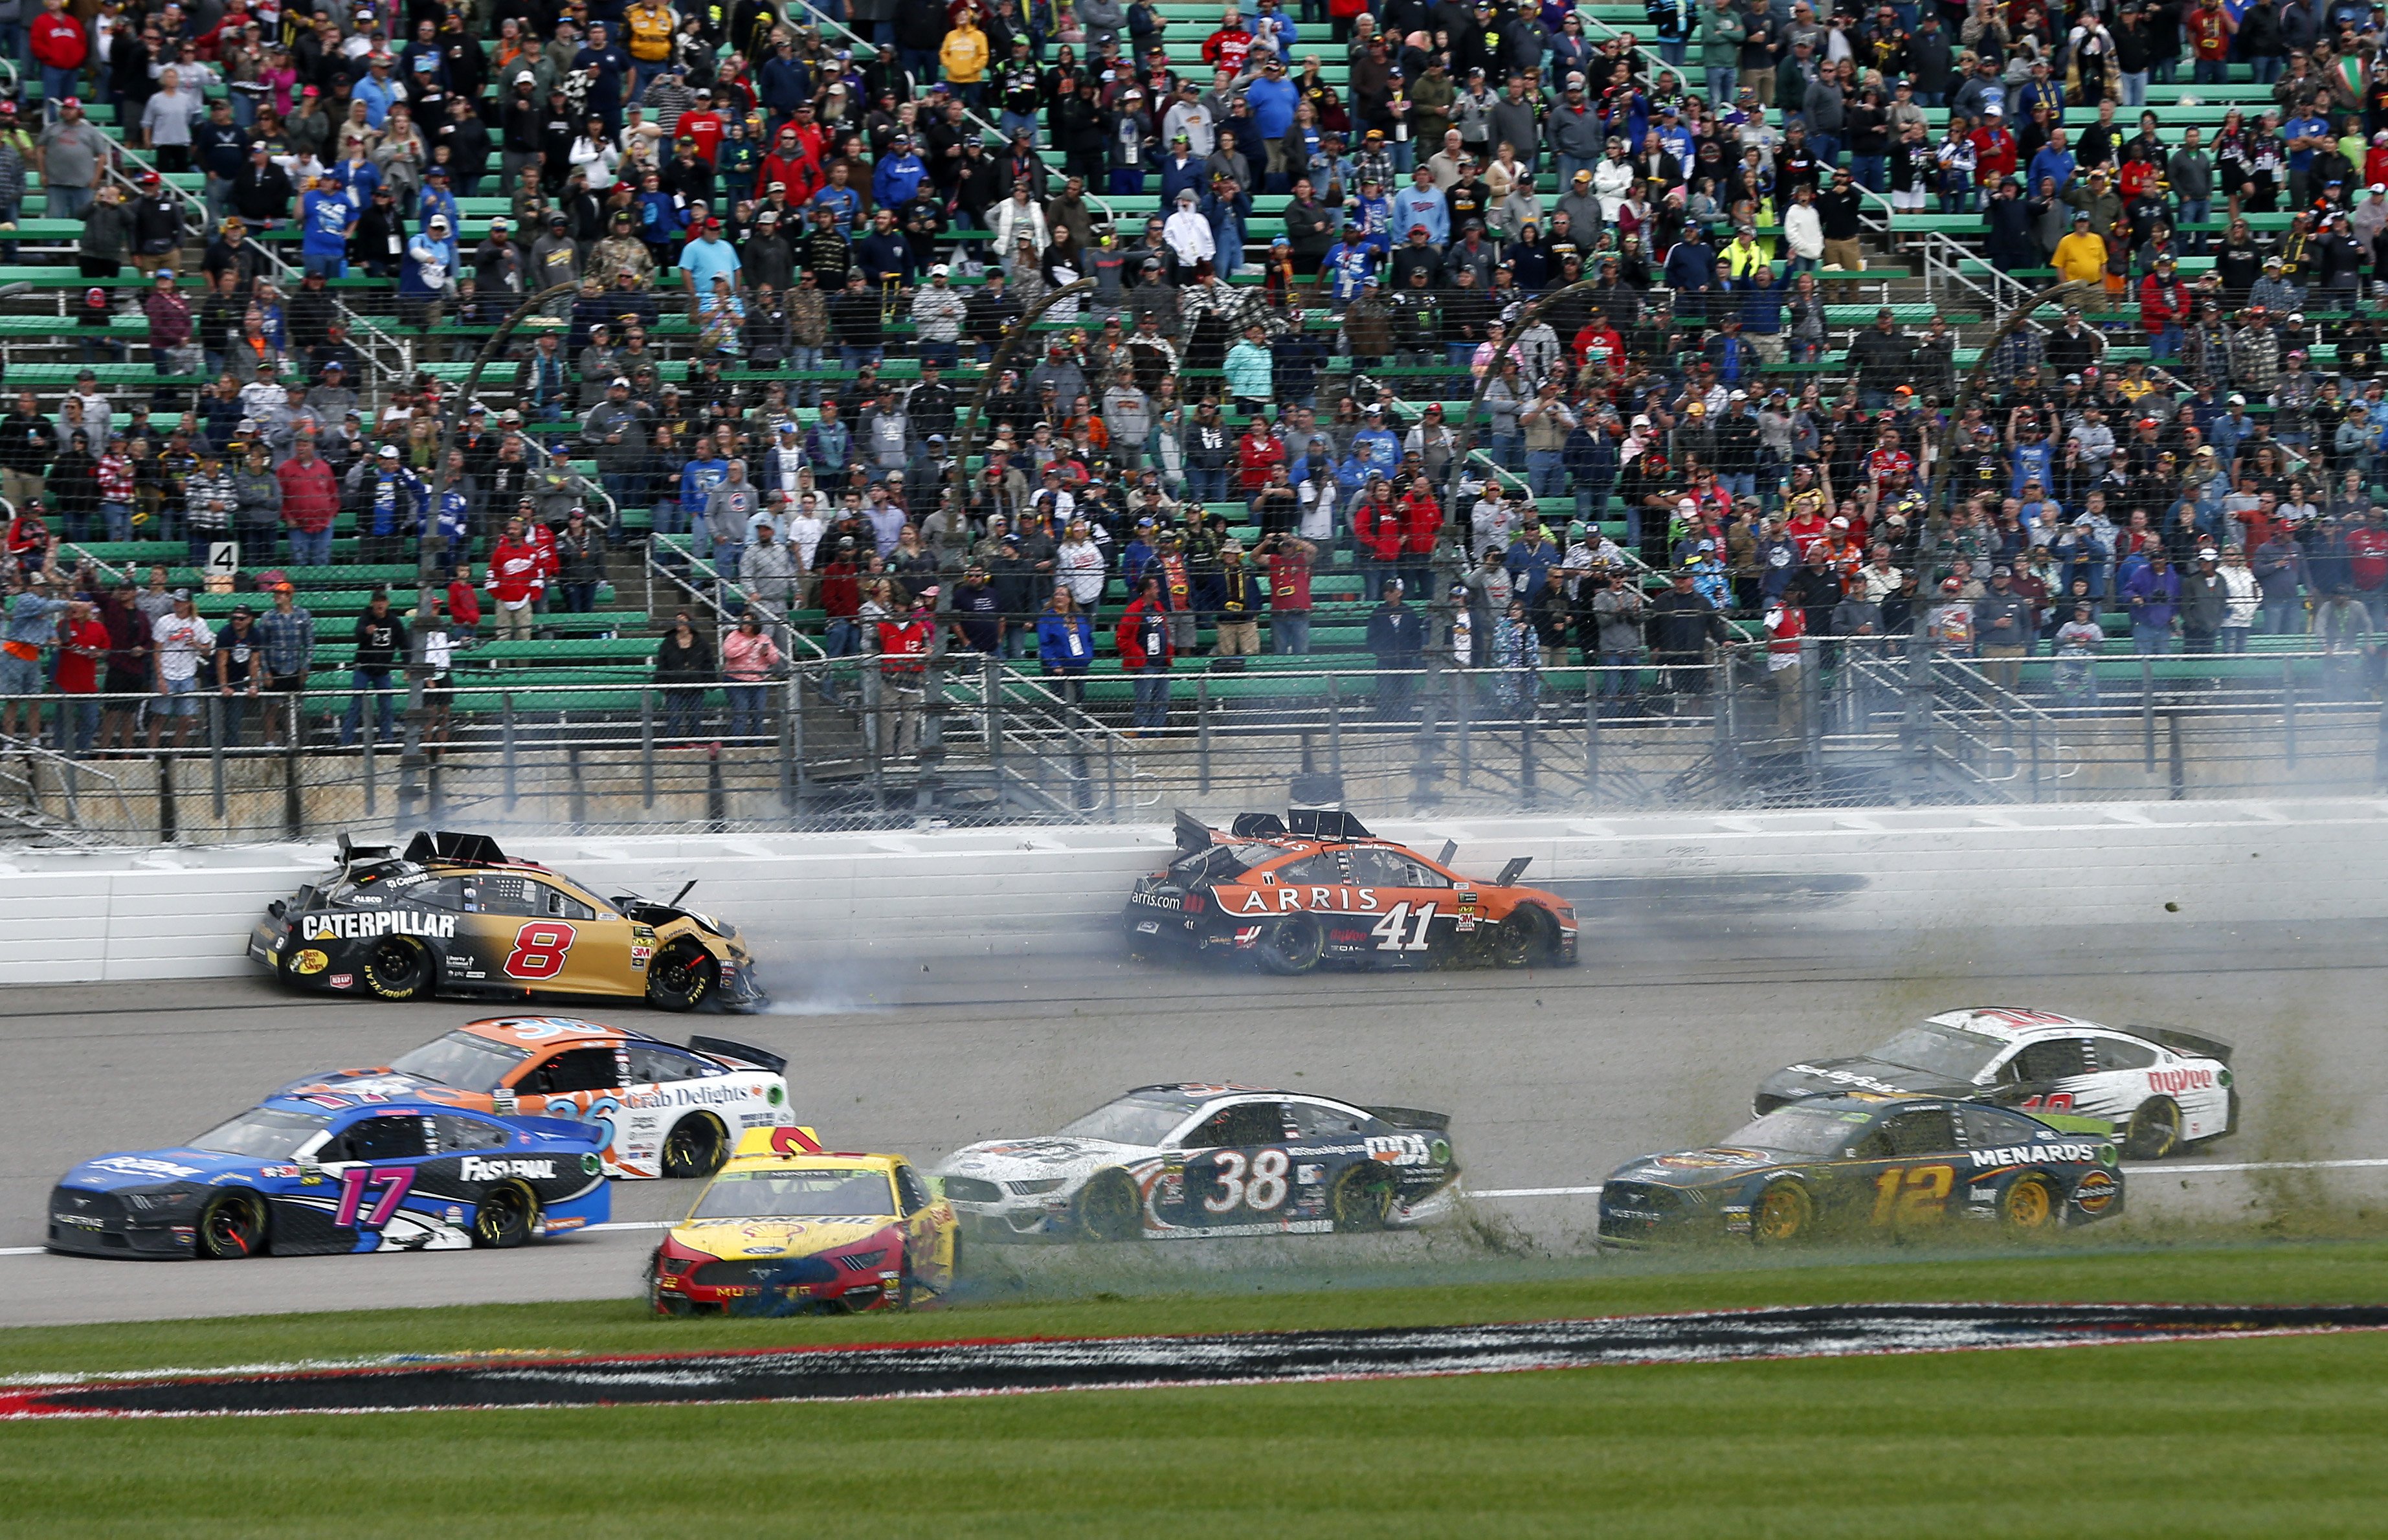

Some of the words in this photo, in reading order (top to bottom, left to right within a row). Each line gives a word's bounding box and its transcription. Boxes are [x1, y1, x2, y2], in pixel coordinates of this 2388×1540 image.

[214, 544, 234, 572] 4
[396, 873, 429, 886] Cessna
[1132, 891, 1181, 910] arris.com
[1242, 887, 1379, 912] ARRIS
[302, 910, 455, 942] CATERPILLAR
[1184, 919, 1196, 930] 41
[1371, 901, 1438, 951] 41
[1460, 915, 1473, 924] 3M
[275, 936, 285, 950] 8
[502, 920, 578, 981] 8
[633, 948, 650, 957] 3M
[676, 1085, 748, 1108] Delights
[1969, 1143, 2095, 1168] MENARDS
[1203, 1148, 1290, 1214] 38
[333, 1166, 418, 1227] 17
[1873, 1164, 1956, 1227] 12
